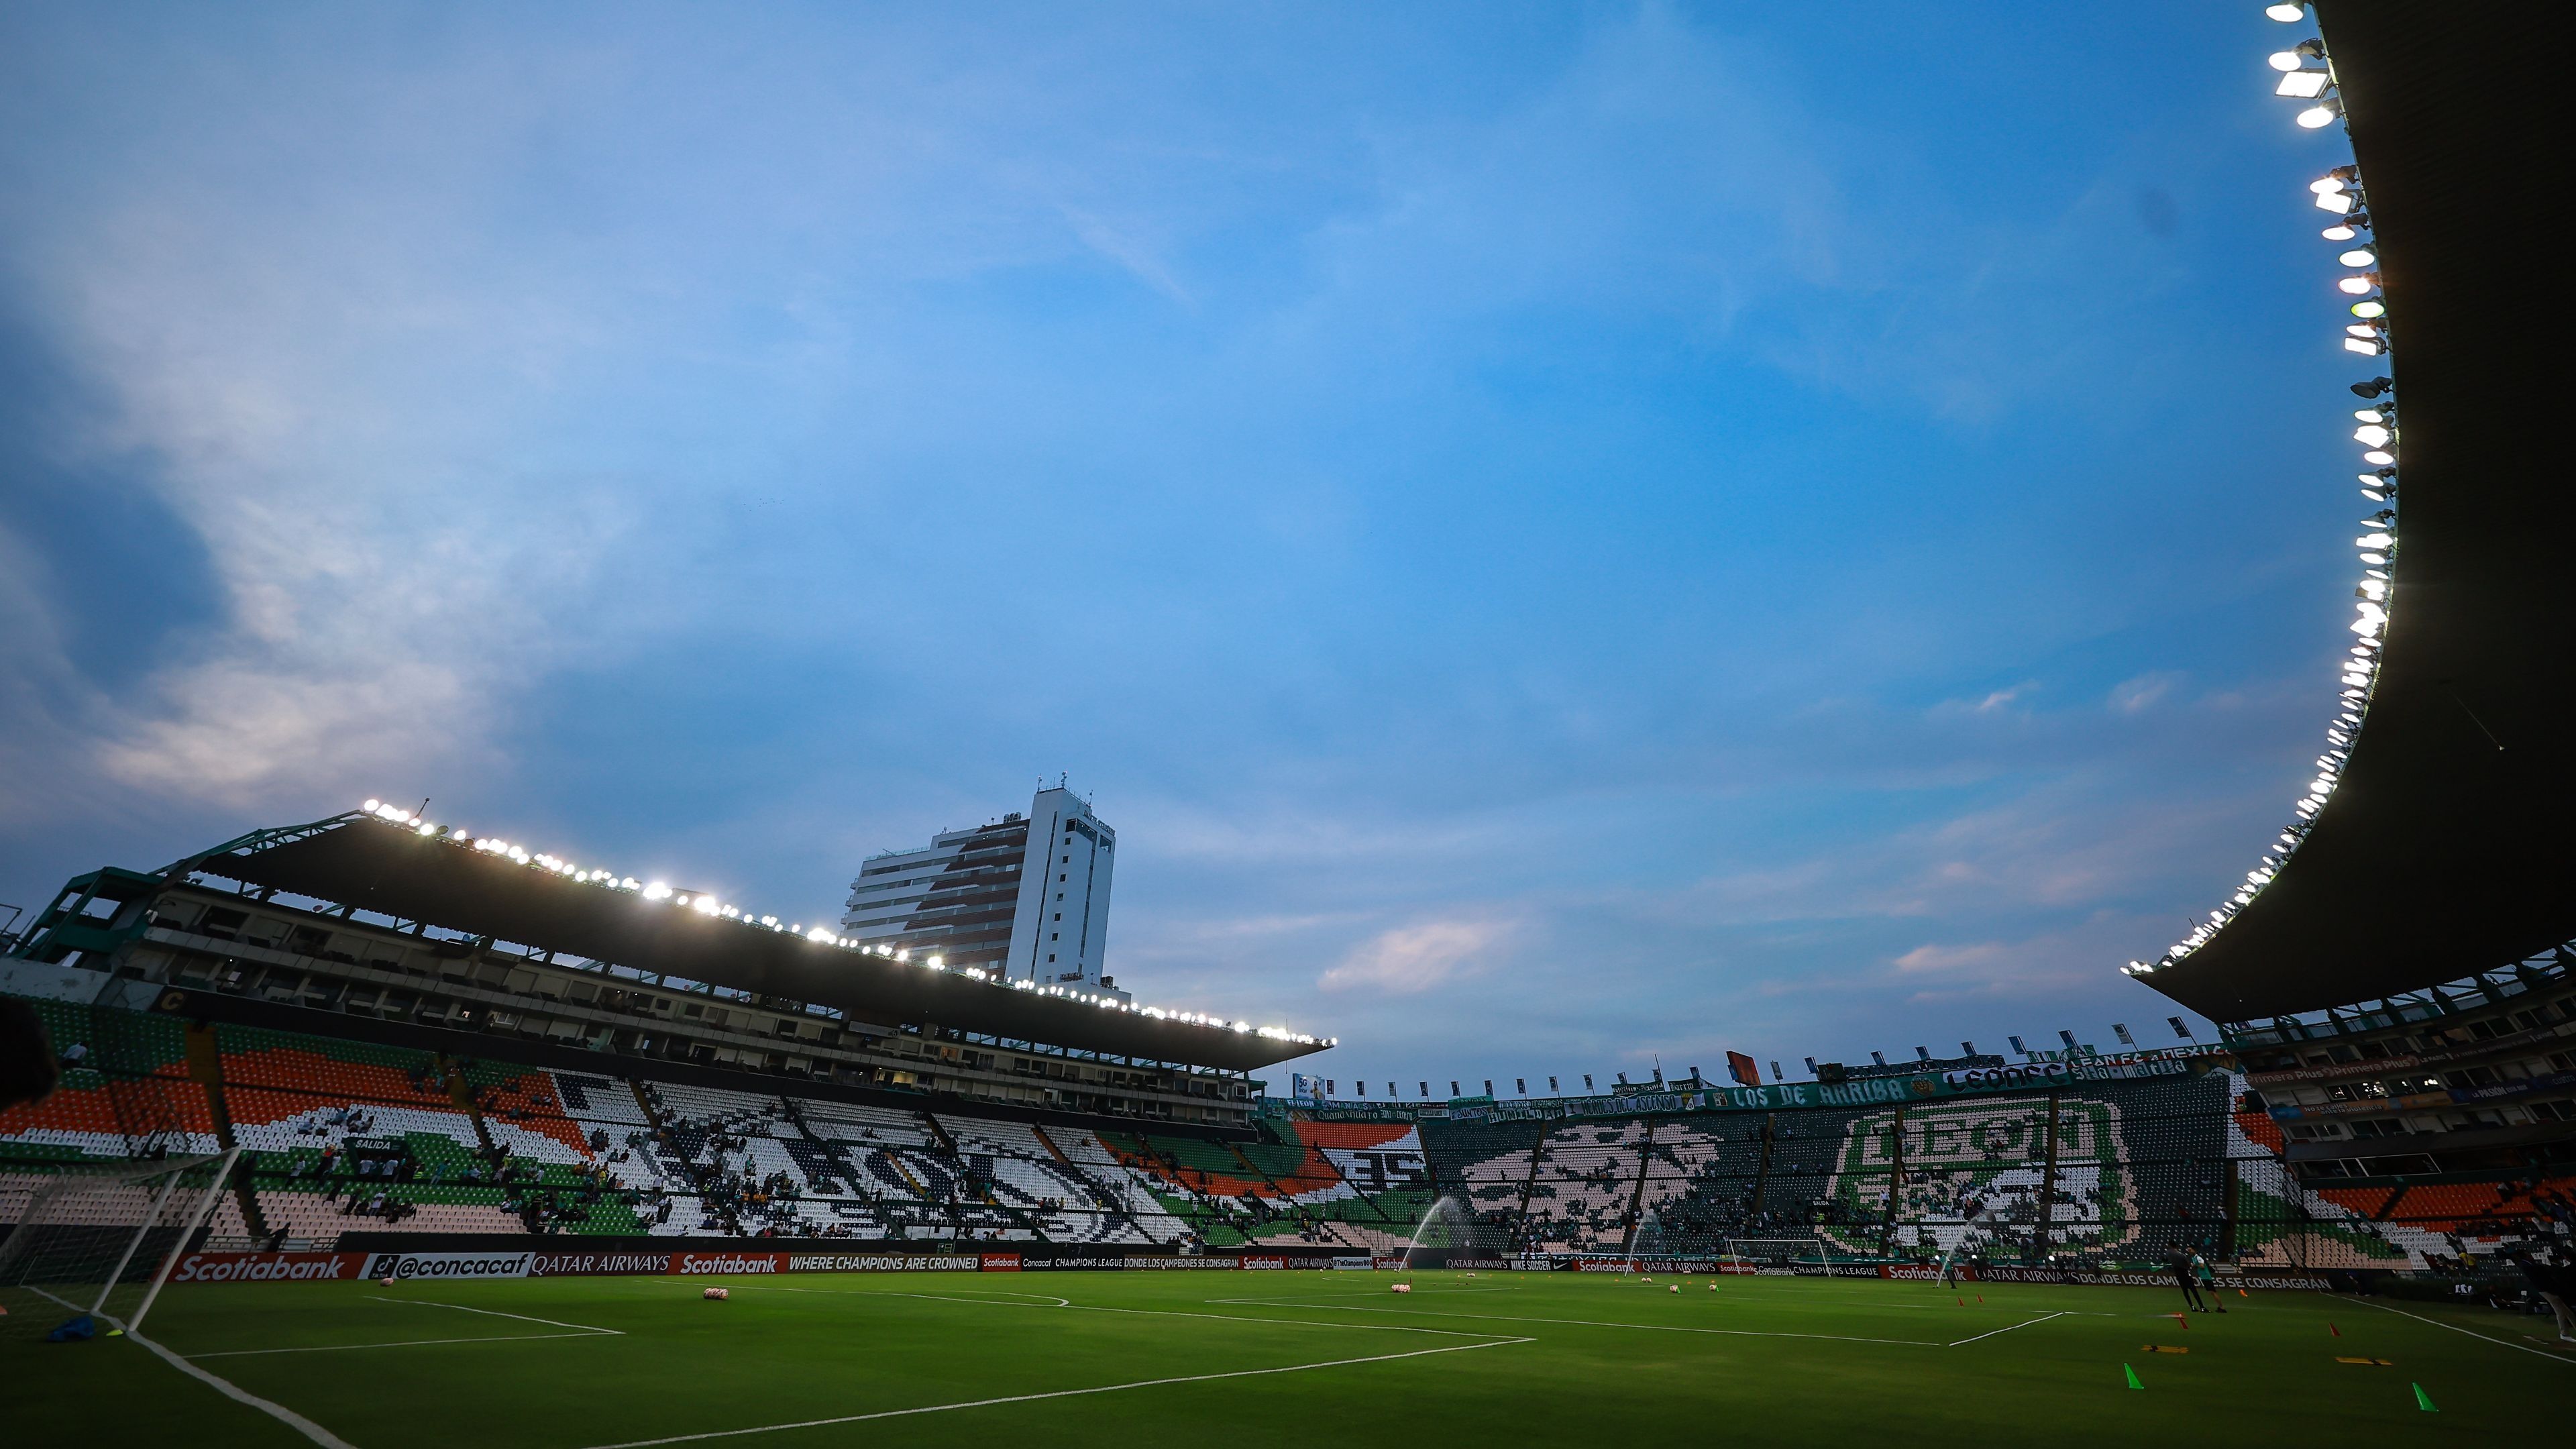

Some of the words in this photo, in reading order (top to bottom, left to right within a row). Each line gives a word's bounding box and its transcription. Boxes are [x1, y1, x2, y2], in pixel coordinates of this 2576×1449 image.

[162, 992, 184, 1010] C
[2334, 1064, 2381, 1076] Primera
[2383, 1059, 2411, 1069] Plus
[2295, 1069, 2324, 1079] Plus
[1299, 1077, 1307, 1087] 5G
[1733, 1088, 1767, 1108] LOS
[1779, 1086, 1806, 1106] DE
[1818, 1079, 1907, 1105] ARRIBA
[1581, 1097, 1615, 1115] HÉROES
[1615, 1097, 1633, 1114] DEL
[1635, 1094, 1676, 1112] ASCENSO
[355, 1139, 390, 1150] SALIDA
[174, 1255, 345, 1281] Scotiabank
[396, 1253, 529, 1279] @concacaf
[531, 1256, 592, 1276] QATAR
[596, 1255, 670, 1272] AIRWAYS
[680, 1254, 777, 1274] Scotiabank
[789, 1256, 835, 1270] WHERE
[836, 1256, 904, 1270] CHAMPIONS
[904, 1257, 926, 1269] ARE
[928, 1257, 978, 1269] CROWNED
[984, 1258, 1018, 1267] Scotiabank
[1023, 1258, 1052, 1267] Concacaf
[1055, 1258, 1096, 1267] CHAMPIONS
[1098, 1258, 1122, 1267] LEAGUE
[1124, 1258, 1147, 1267] DONDE
[1148, 1258, 1160, 1267] LOS
[1161, 1258, 1197, 1267] CAMPEONES
[1197, 1258, 1205, 1267] SE
[1206, 1258, 1238, 1267] CONSAGRAN
[1244, 1257, 1284, 1270] Scotiabank
[1289, 1258, 1308, 1268] QATAR
[1309, 1258, 1333, 1268] AIRWAYS
[1377, 1258, 1408, 1269] Scotiabank
[1447, 1259, 1473, 1269] QATAR
[1474, 1260, 1507, 1269] AIRWAYS
[1511, 1260, 1526, 1271] NIKE
[1527, 1260, 1551, 1271] SOCCER
[1580, 1260, 1635, 1273] Scotiabank
[1642, 1263, 1673, 1273] QATAR
[1676, 1263, 1715, 1272] AIRWAYS
[1793, 1266, 1843, 1275] CHAMPIONS
[1845, 1267, 1878, 1275] LEAGUE
[2081, 1273, 2122, 1285] DONDE
[2124, 1275, 2146, 1285] LOS
[2226, 1277, 2243, 1288] SE
[2245, 1277, 2332, 1290] CONSAGRAN
